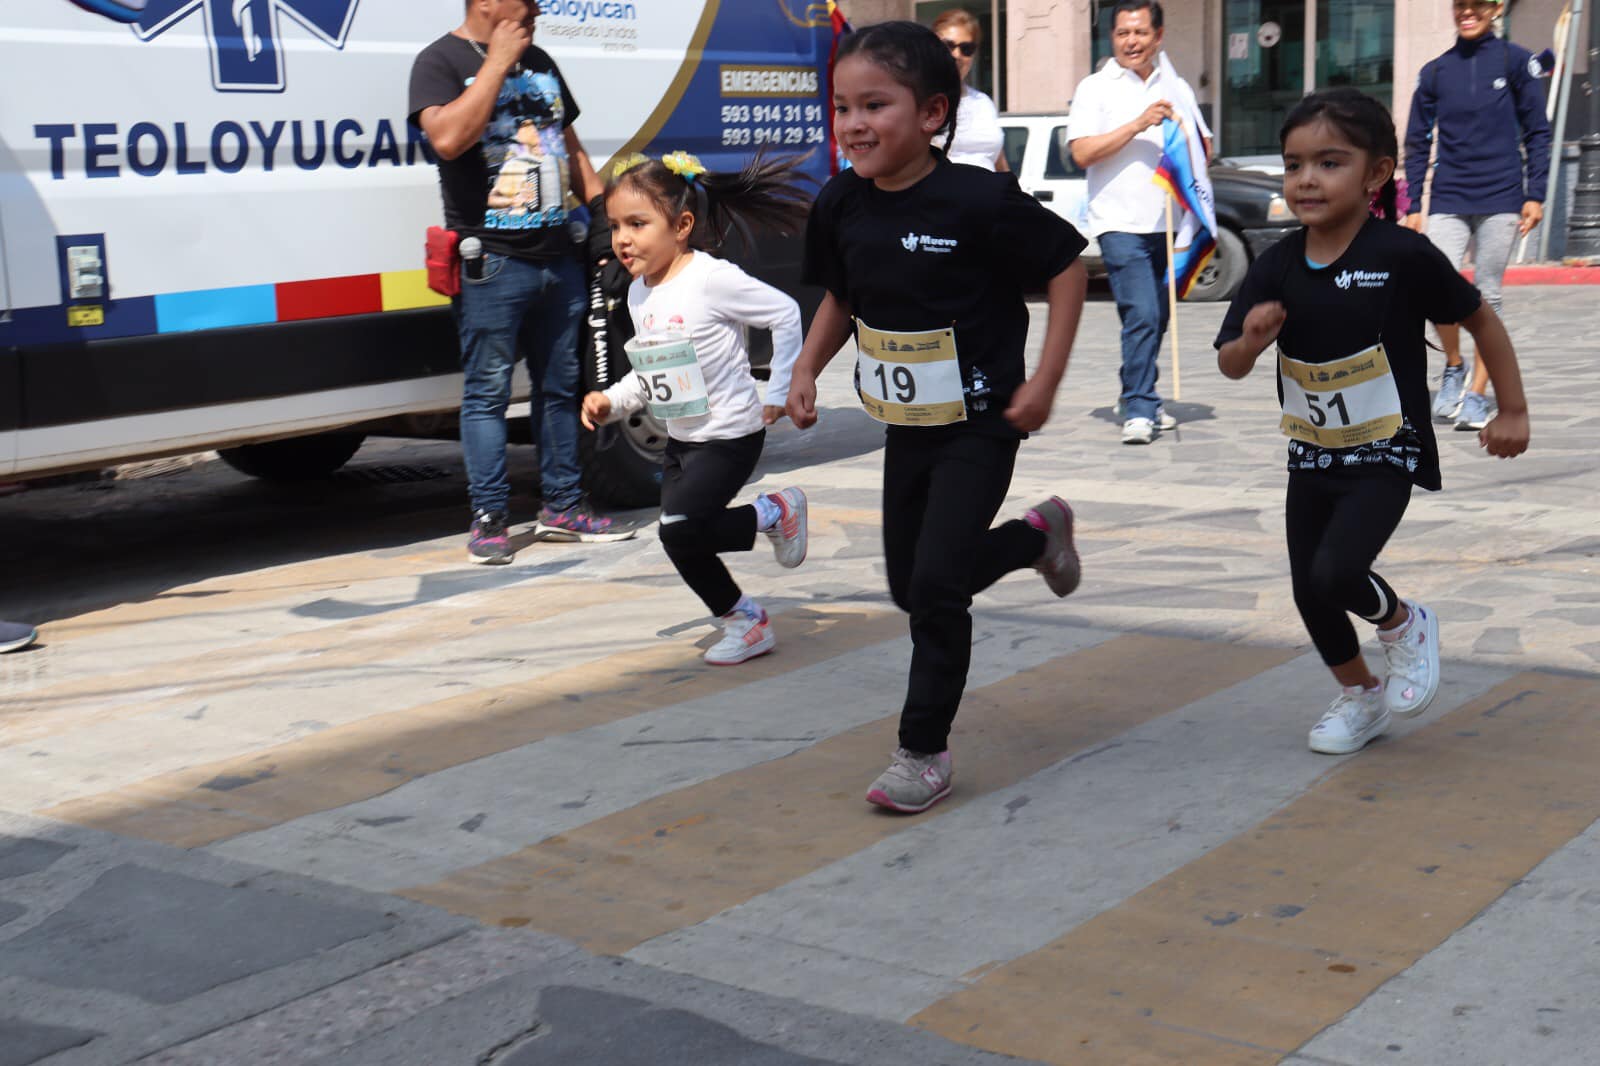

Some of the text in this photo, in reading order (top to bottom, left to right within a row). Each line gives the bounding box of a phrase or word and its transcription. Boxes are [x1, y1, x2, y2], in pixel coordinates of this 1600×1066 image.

[538, 0, 636, 22] eoloyucan
[721, 70, 818, 93] EMERGENCIAS
[721, 104, 822, 123] 593 914 31 91
[721, 126, 825, 146] 593 914 29 34
[919, 234, 958, 248] Mueve
[1353, 269, 1390, 281] Mueve
[874, 363, 916, 403] 19
[1305, 392, 1351, 427] 51
